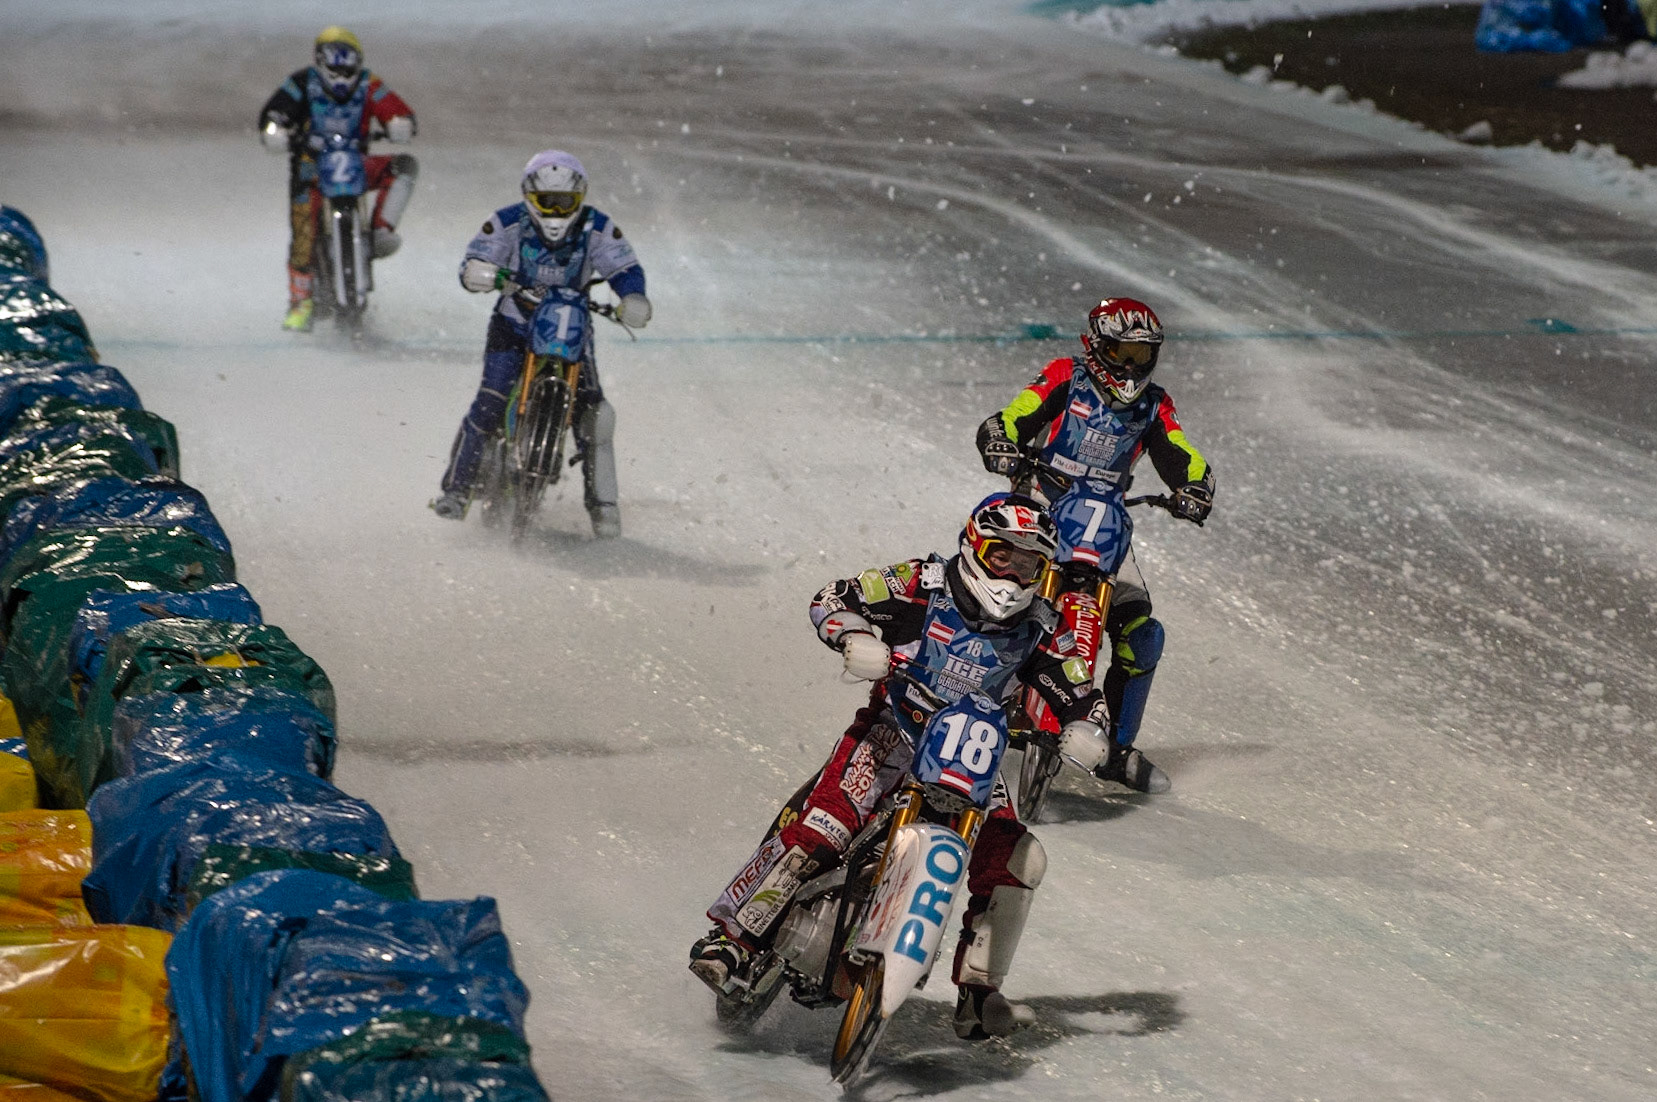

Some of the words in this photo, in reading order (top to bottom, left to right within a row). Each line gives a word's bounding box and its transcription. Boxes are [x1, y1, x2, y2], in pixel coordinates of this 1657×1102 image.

[331, 150, 352, 182] 2
[555, 304, 573, 340] 1
[1081, 499, 1108, 543] 7
[966, 640, 983, 658] 18
[943, 656, 987, 683] ICE
[939, 712, 998, 775] 18
